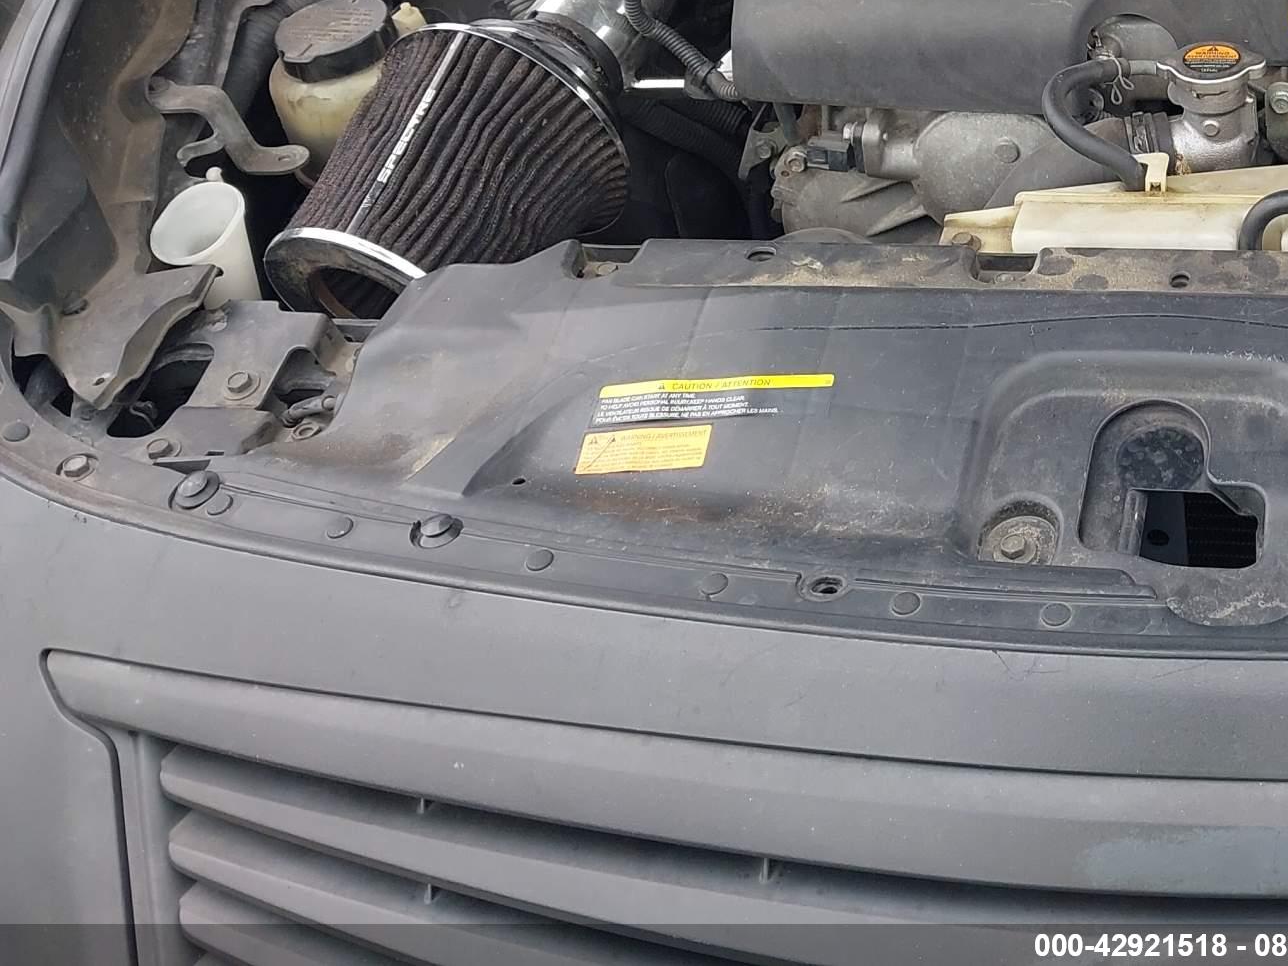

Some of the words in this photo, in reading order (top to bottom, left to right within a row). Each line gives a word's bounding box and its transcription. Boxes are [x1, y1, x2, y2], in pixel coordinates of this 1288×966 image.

[376, 88, 437, 184] SPECTRE
[672, 383, 713, 391] CAUTION
[720, 379, 772, 389] ATTENTION
